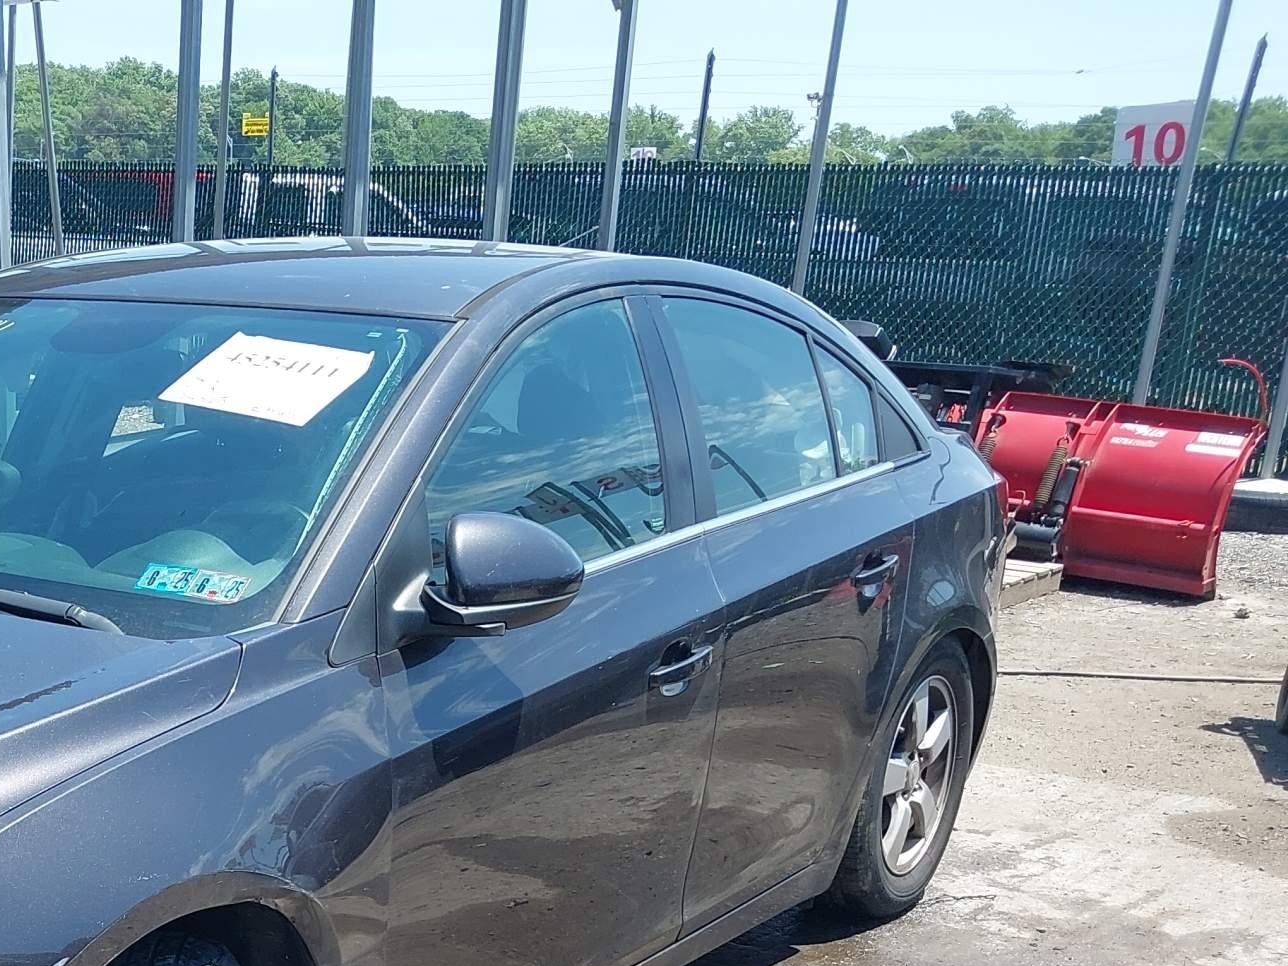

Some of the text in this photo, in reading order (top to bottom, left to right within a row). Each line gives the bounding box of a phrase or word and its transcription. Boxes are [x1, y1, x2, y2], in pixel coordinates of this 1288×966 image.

[1124, 121, 1185, 167] 10
[226, 352, 339, 377] 45254111
[147, 570, 193, 589] 6 25
[196, 578, 244, 599] 6 25
